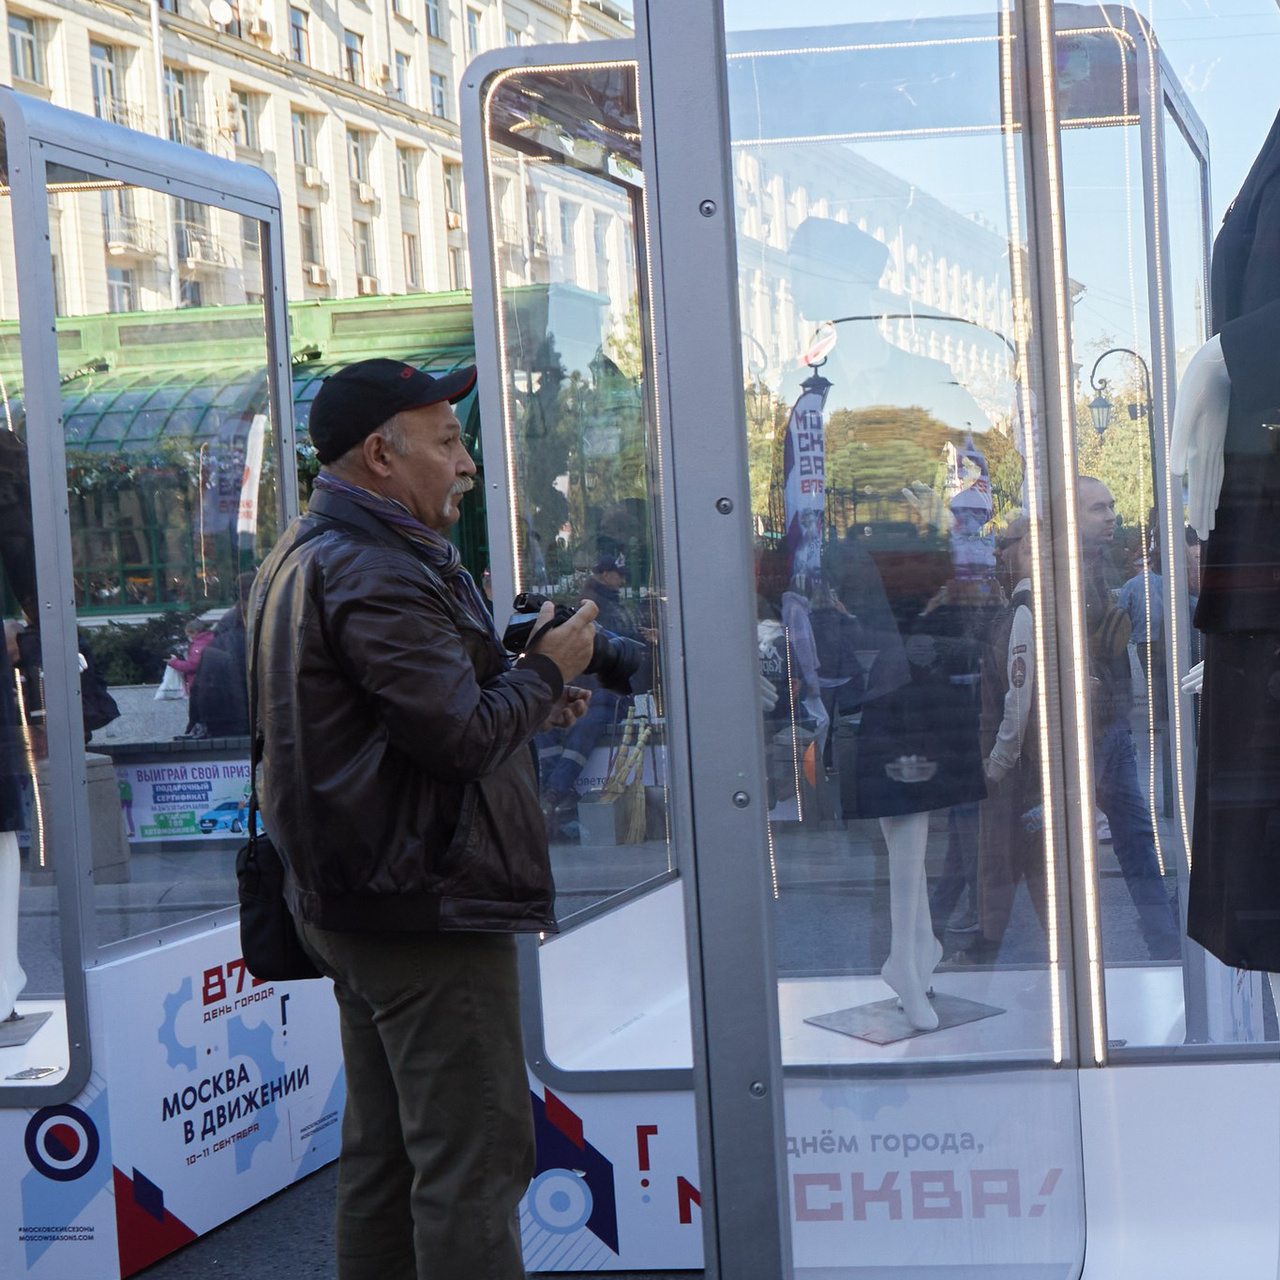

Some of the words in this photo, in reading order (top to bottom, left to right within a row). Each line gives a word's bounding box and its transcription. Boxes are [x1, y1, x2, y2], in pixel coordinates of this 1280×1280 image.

[137, 767, 187, 783] ВЫИГРАЙ
[190, 764, 220, 780] СВОЙ
[223, 764, 250, 779] ПРИЗ
[203, 1004, 232, 1024] ДЕНЬ
[234, 986, 275, 1010] ГОРОДА
[161, 1062, 250, 1122] МОСКВА
[183, 1120, 195, 1146] В
[200, 1064, 310, 1142] ДВИЖЕНИИ
[213, 1123, 260, 1153] СЕНТЯБРЯ
[870, 1131, 985, 1158] города,
